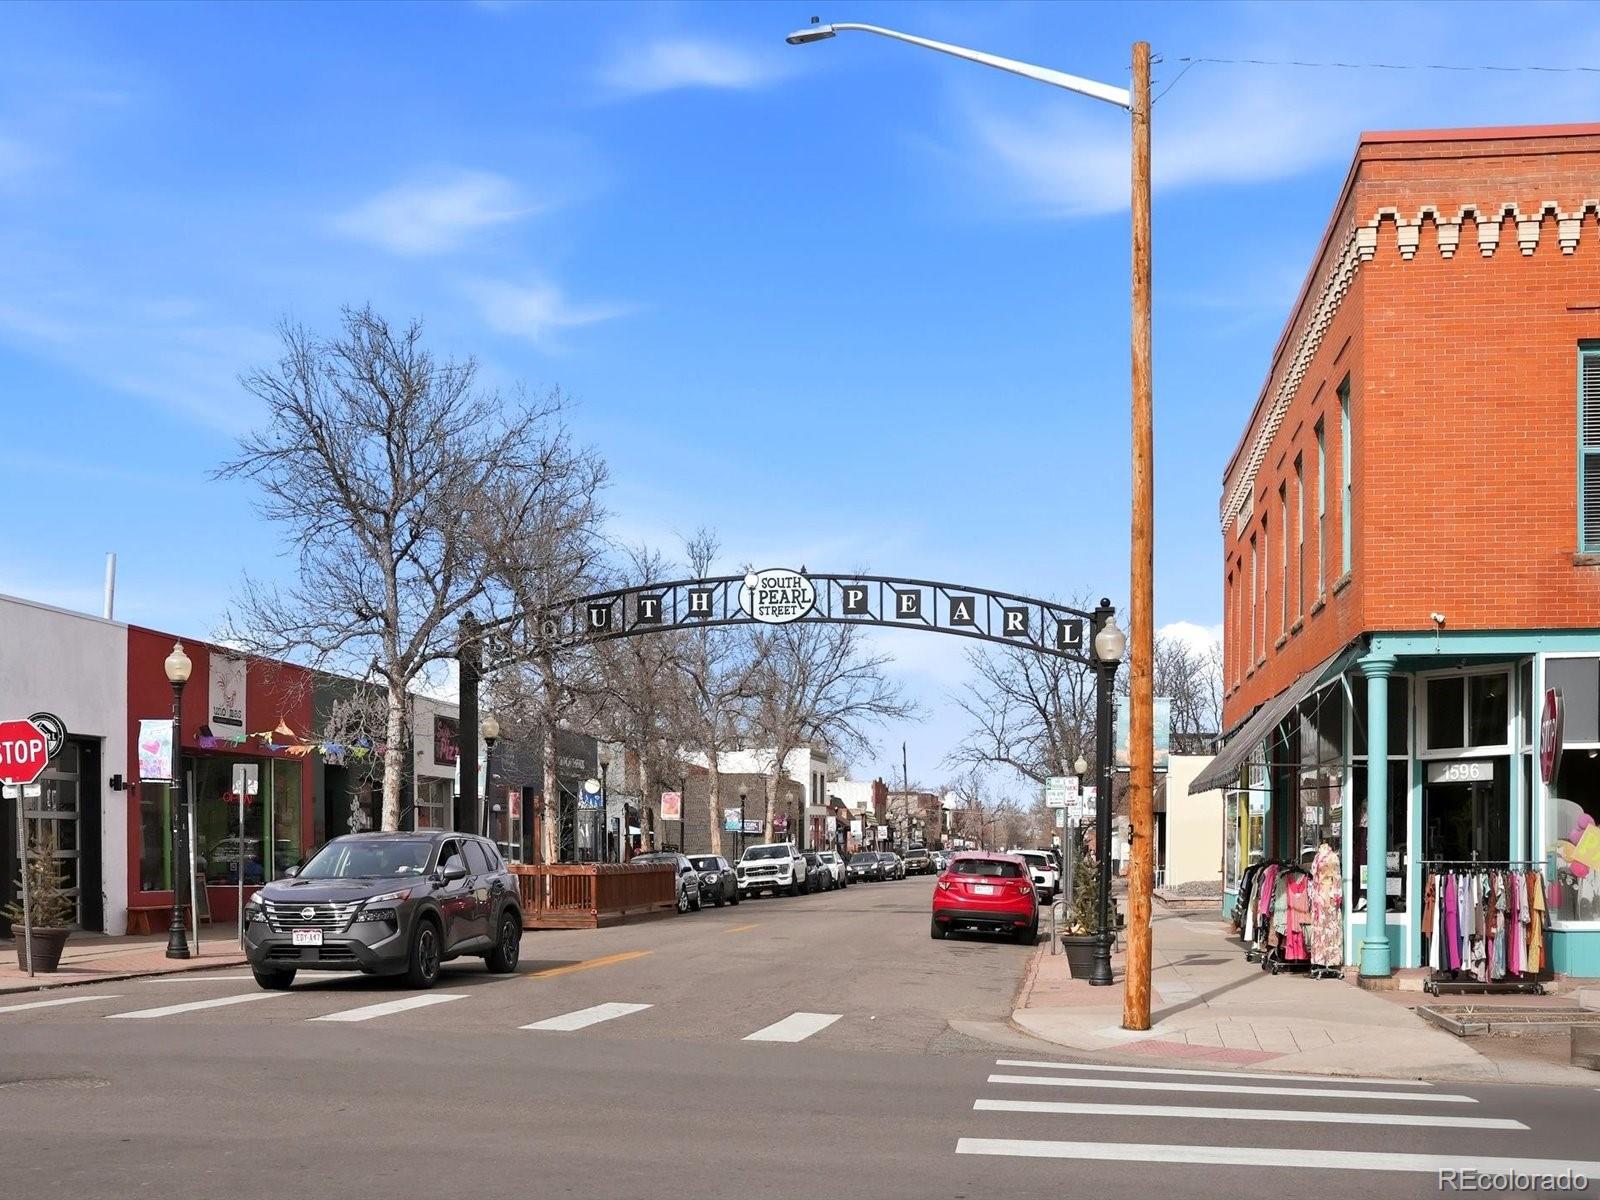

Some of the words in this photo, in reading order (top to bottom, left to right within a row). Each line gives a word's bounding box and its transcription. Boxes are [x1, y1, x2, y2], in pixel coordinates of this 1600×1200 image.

[761, 577, 802, 589] SOUTH
[758, 588, 811, 609] PEARL
[758, 605, 797, 617] STREET
[847, 590, 1079, 644] PEARL
[1541, 718, 1556, 754] STOP
[1442, 763, 1480, 780] 1596
